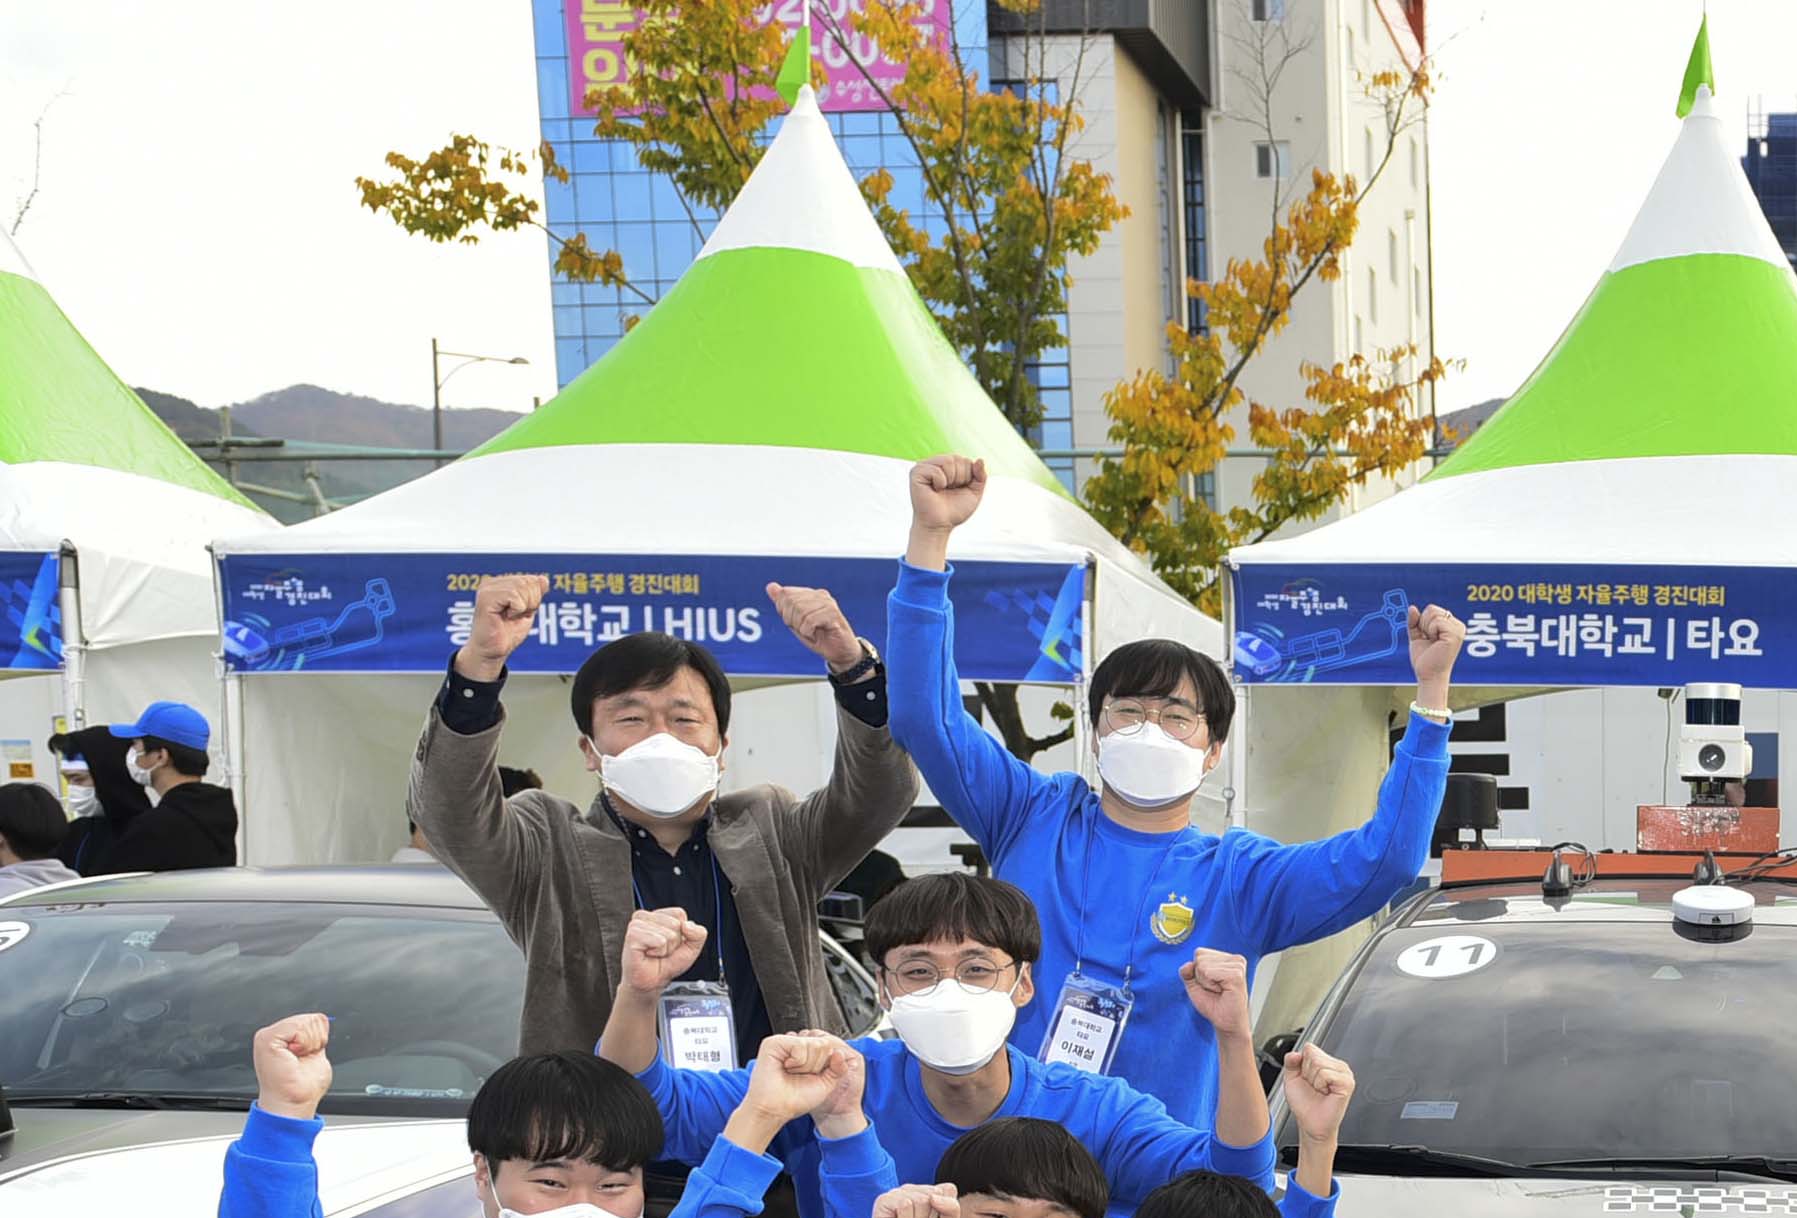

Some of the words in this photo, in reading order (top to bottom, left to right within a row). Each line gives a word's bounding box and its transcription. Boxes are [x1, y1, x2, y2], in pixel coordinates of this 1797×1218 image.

[447, 574, 490, 591] 202
[554, 573, 625, 595] 자율주행
[629, 573, 699, 595] 경진대회
[1467, 585, 1514, 602] 2020
[1518, 583, 1573, 605] 대학생
[1576, 584, 1649, 606] 자율주행
[1653, 585, 1726, 607] 경진대회
[446, 600, 630, 646] 홍대학교
[664, 606, 762, 643] HIUS
[1464, 612, 1656, 658] 충북대학교
[1686, 616, 1763, 660] 타요
[1417, 943, 1485, 966] 11
